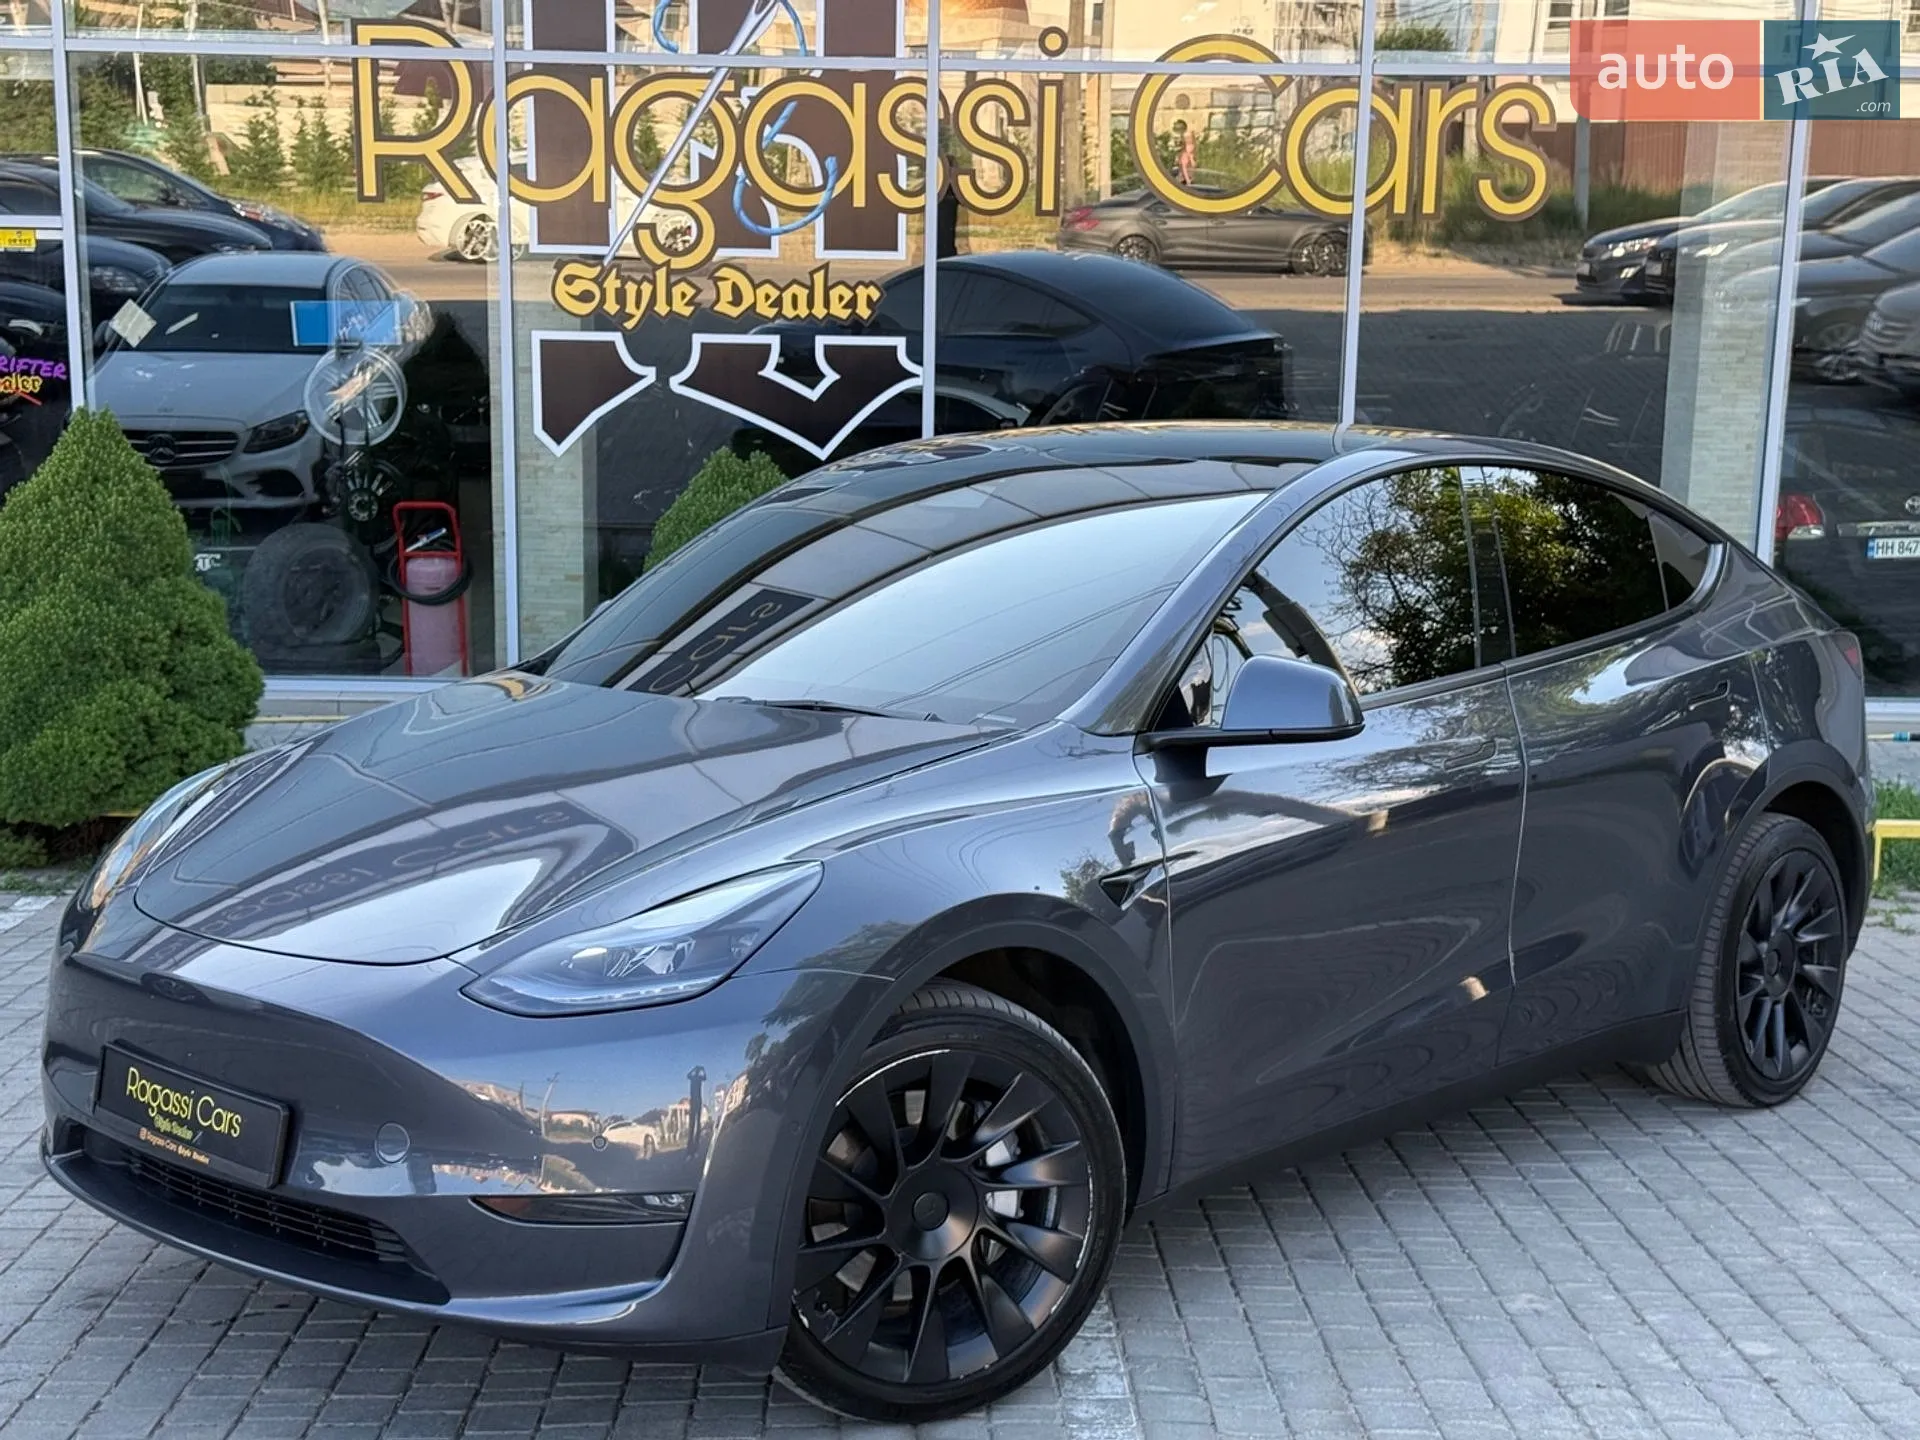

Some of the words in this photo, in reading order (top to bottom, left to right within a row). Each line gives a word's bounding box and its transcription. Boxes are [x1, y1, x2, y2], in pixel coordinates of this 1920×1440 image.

[352, 19, 1069, 270] Ragassi
[1129, 33, 1557, 222] Cars
[553, 258, 700, 330] Style
[712, 262, 882, 322] Dealer
[126, 1066, 195, 1118] Ragassi
[196, 1095, 243, 1138] Cars
